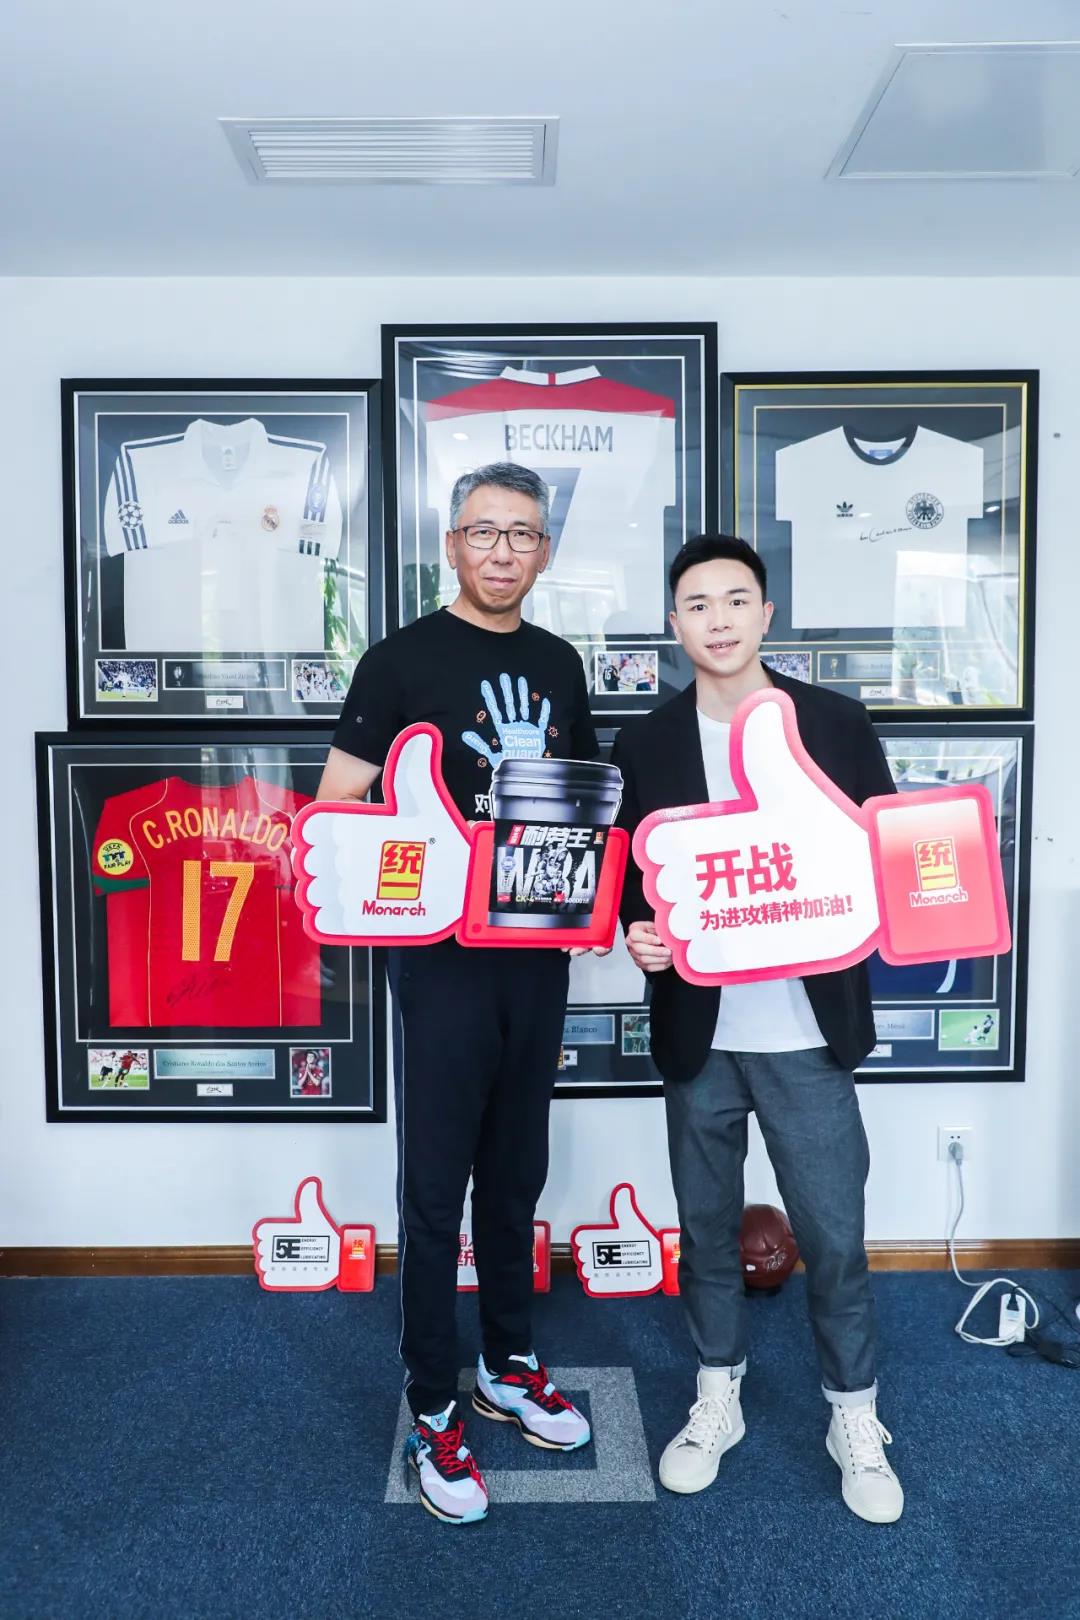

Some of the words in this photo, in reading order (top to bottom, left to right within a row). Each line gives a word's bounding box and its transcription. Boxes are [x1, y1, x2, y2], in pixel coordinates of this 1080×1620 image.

[504, 424, 614, 452] BECKHAM
[504, 735, 541, 747] Clean
[142, 807, 288, 852] C.RONALDO
[695, 842, 797, 901] 开战
[911, 888, 967, 906] Monarch
[181, 860, 255, 962] 17
[362, 900, 426, 916] Monarch
[276, 1238, 300, 1259] 5E
[596, 1244, 622, 1265] 5E
